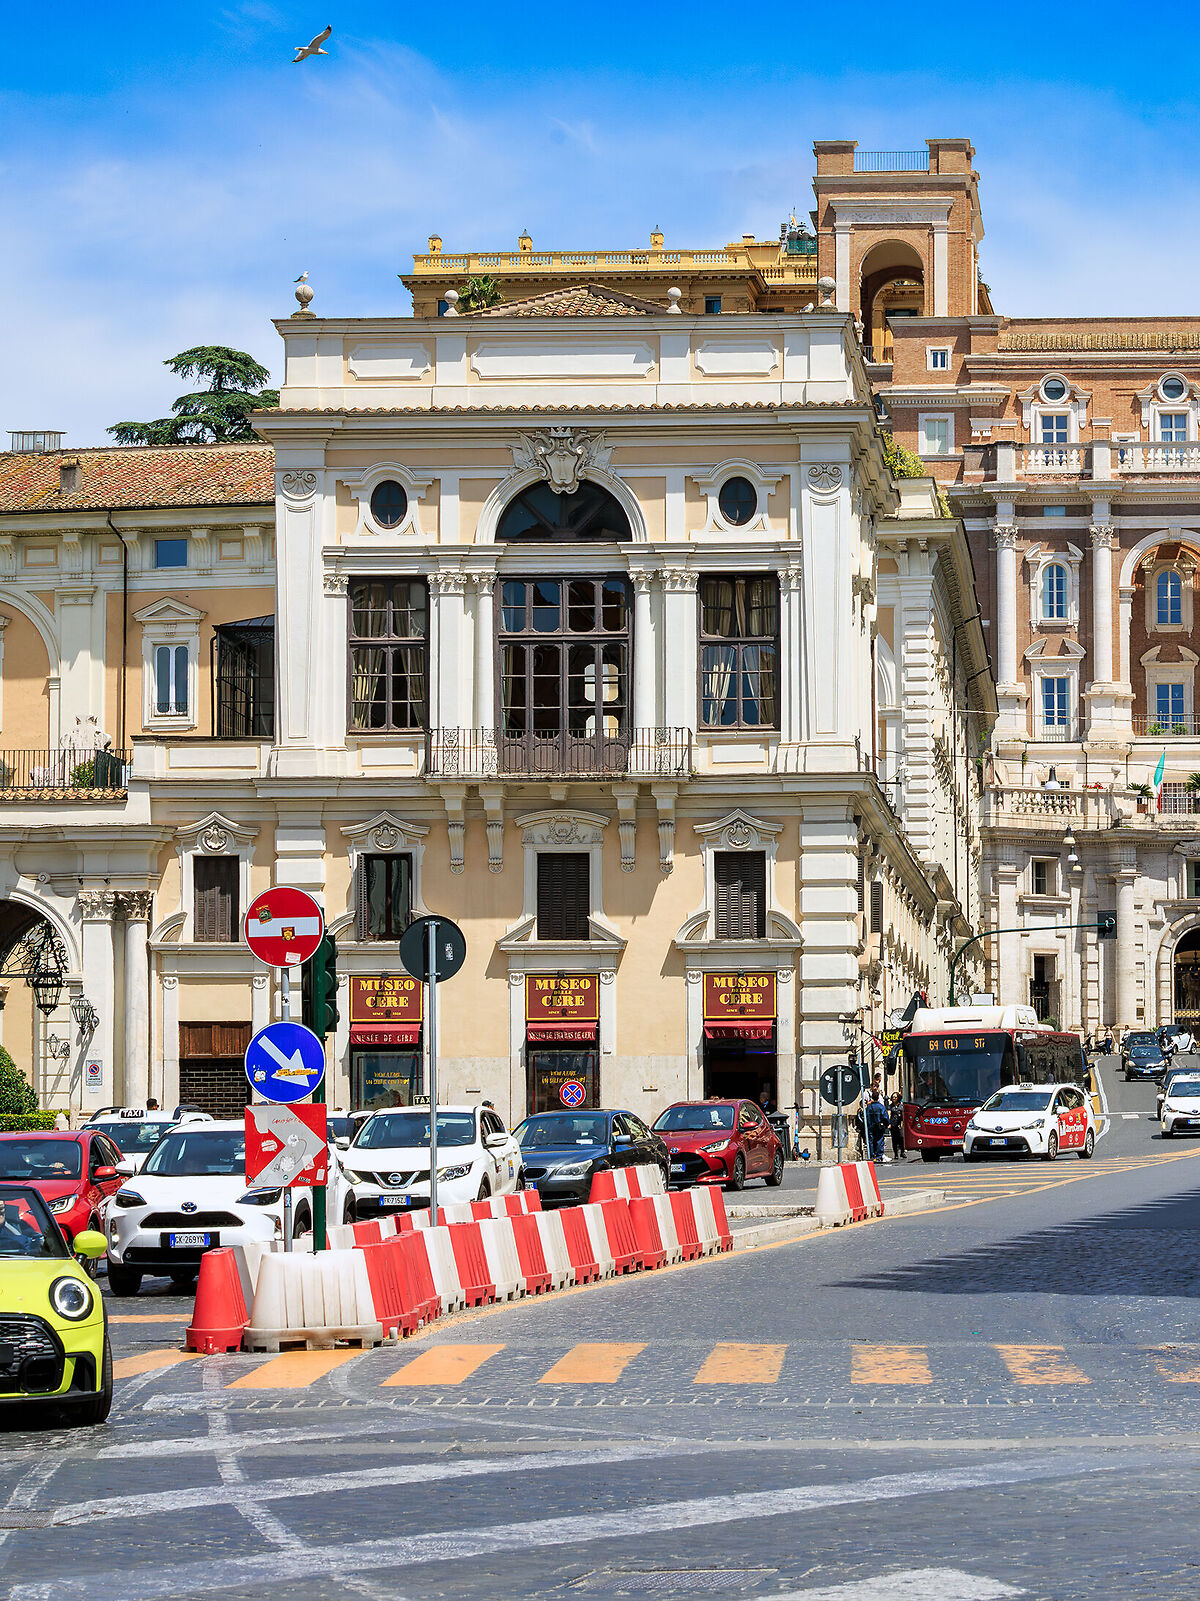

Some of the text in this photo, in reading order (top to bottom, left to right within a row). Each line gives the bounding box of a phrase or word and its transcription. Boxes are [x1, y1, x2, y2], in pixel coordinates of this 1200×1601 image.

[359, 979, 416, 991] MUSEO
[535, 978, 591, 991] MUSEO
[712, 976, 769, 988] MUSEO
[365, 996, 409, 1008] CERE
[541, 995, 585, 1007] CERE
[719, 993, 763, 1005] CERE
[383, 1033, 393, 1042] DE
[733, 1029, 768, 1037] MUSEUM
[929, 1040, 939, 1051] 64
[943, 1038, 959, 1050] (FL)
[122, 1109, 142, 1118] TAXI
